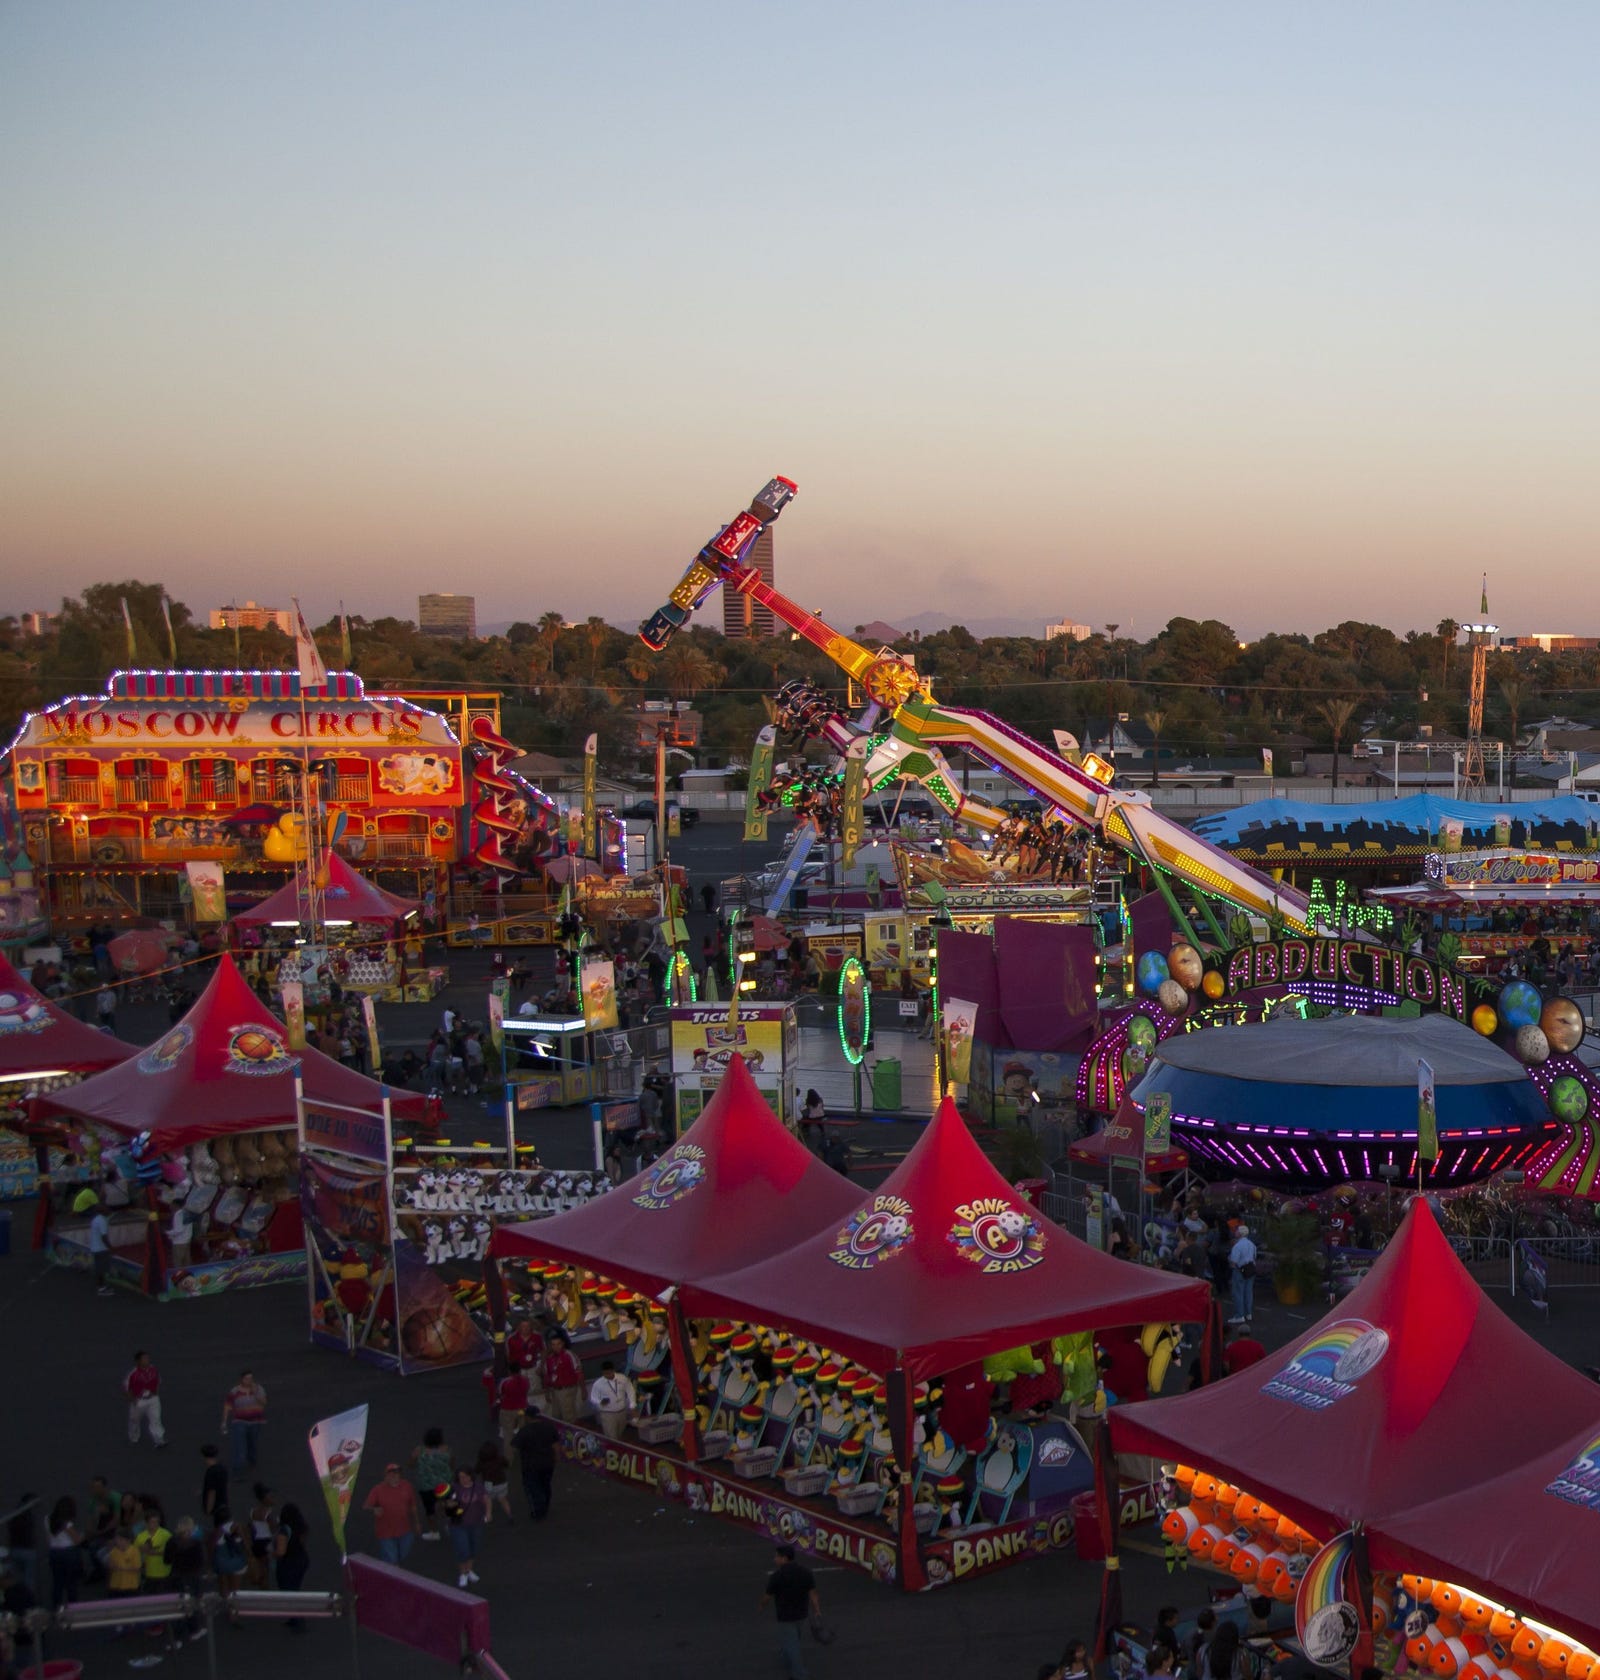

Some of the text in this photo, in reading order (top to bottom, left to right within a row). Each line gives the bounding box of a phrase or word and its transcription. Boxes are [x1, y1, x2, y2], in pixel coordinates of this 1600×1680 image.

[41, 711, 424, 738] MOSCOW CIRCUS
[1452, 859, 1598, 882] Balloon POP
[992, 895, 1064, 905] DOGS
[1228, 940, 1468, 1023] ABDUCTION
[692, 1010, 760, 1024] TICKTS
[674, 1144, 707, 1160] BANK
[659, 1168, 680, 1187] A
[631, 1194, 671, 1210] BALL
[872, 1195, 914, 1217] BANK
[953, 1197, 1012, 1223] BANK
[858, 1221, 883, 1243] A
[985, 1224, 1009, 1250] A
[828, 1248, 875, 1270] BALL
[981, 1253, 1045, 1274] BALL
[1270, 1361, 1359, 1399] RAINBOW
[604, 1448, 659, 1485] BALL
[1544, 1479, 1599, 1508] COIN
[1120, 1497, 1156, 1525] AL
[710, 1479, 765, 1524] BANK
[814, 1526, 874, 1570] BALL
[952, 1528, 1029, 1578] BANK
